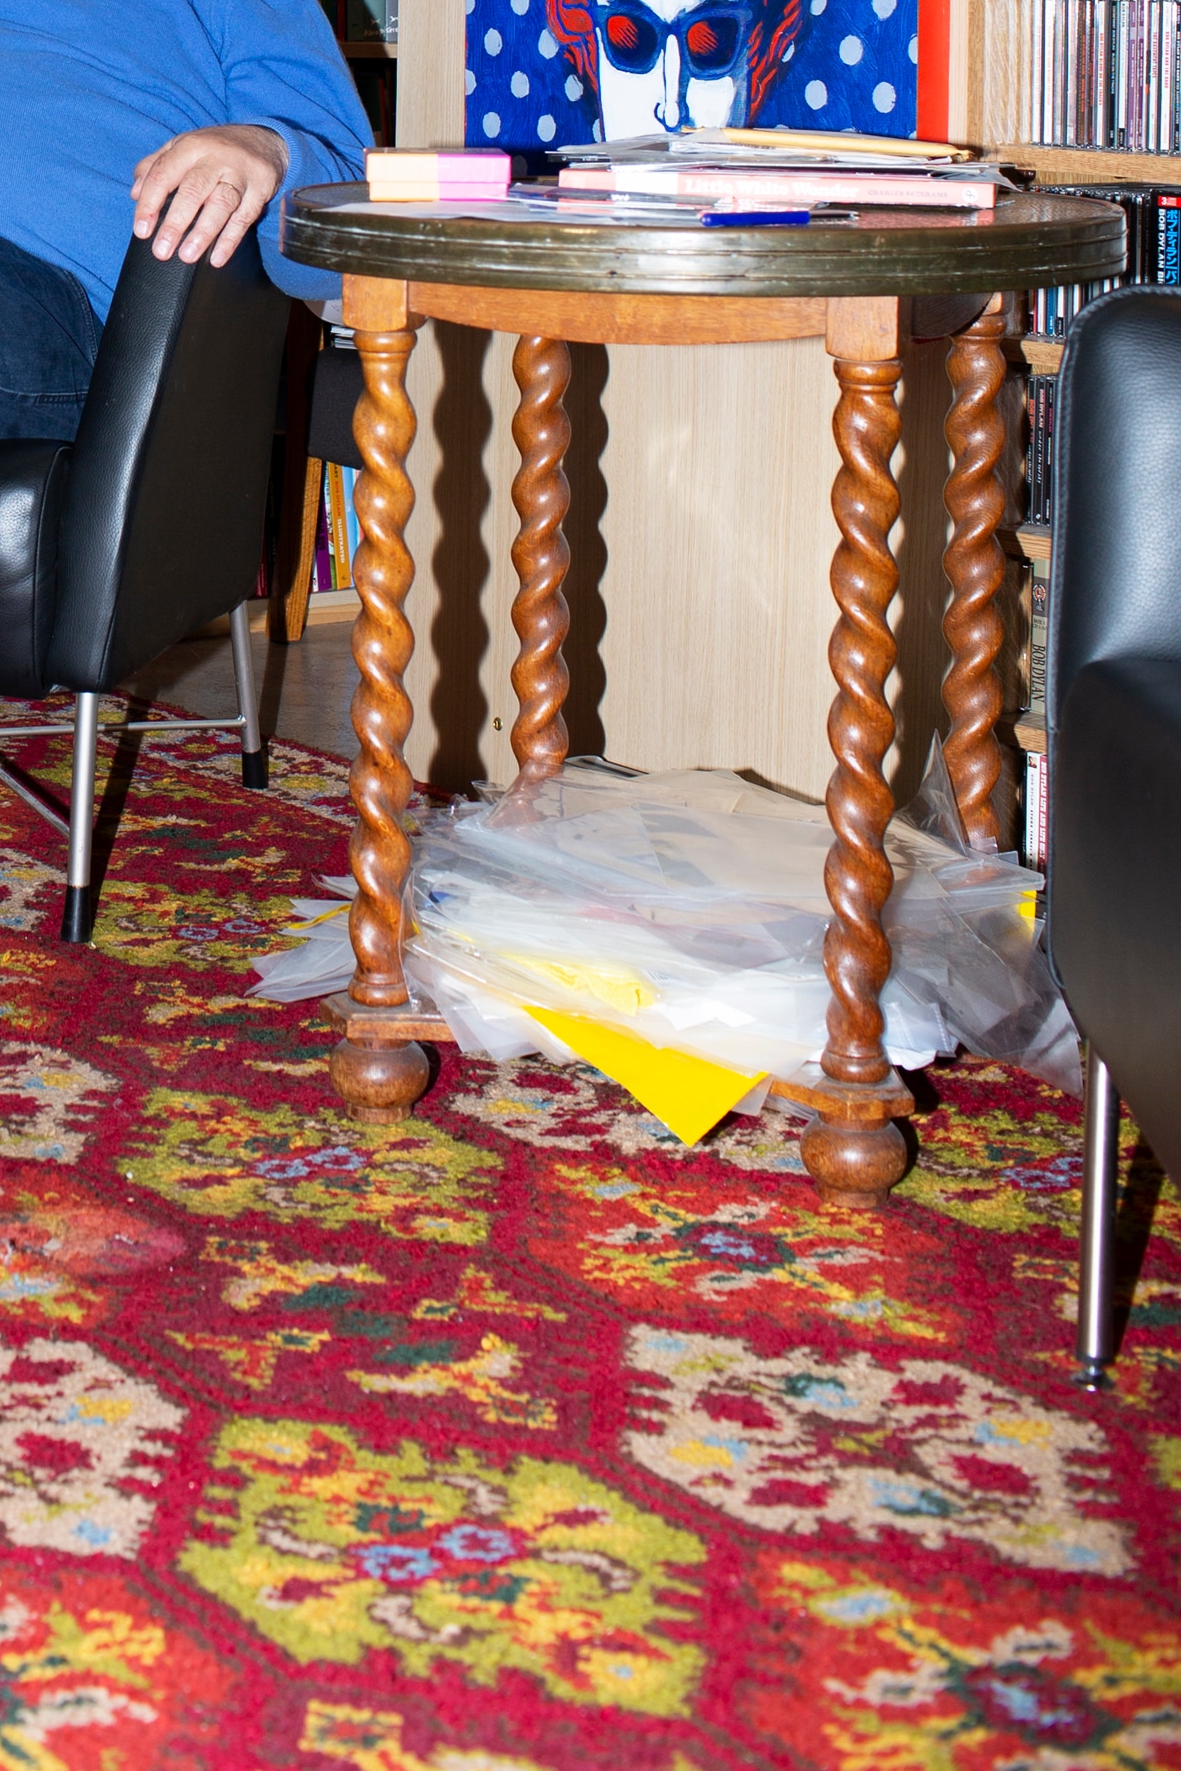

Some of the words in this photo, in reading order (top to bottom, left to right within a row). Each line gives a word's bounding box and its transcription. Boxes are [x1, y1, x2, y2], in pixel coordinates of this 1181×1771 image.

[684, 178, 733, 196] Little
[736, 180, 792, 197] White
[793, 182, 859, 199] Wonder
[1032, 643, 1046, 668] BOB
[1031, 668, 1045, 703] DYLAN
